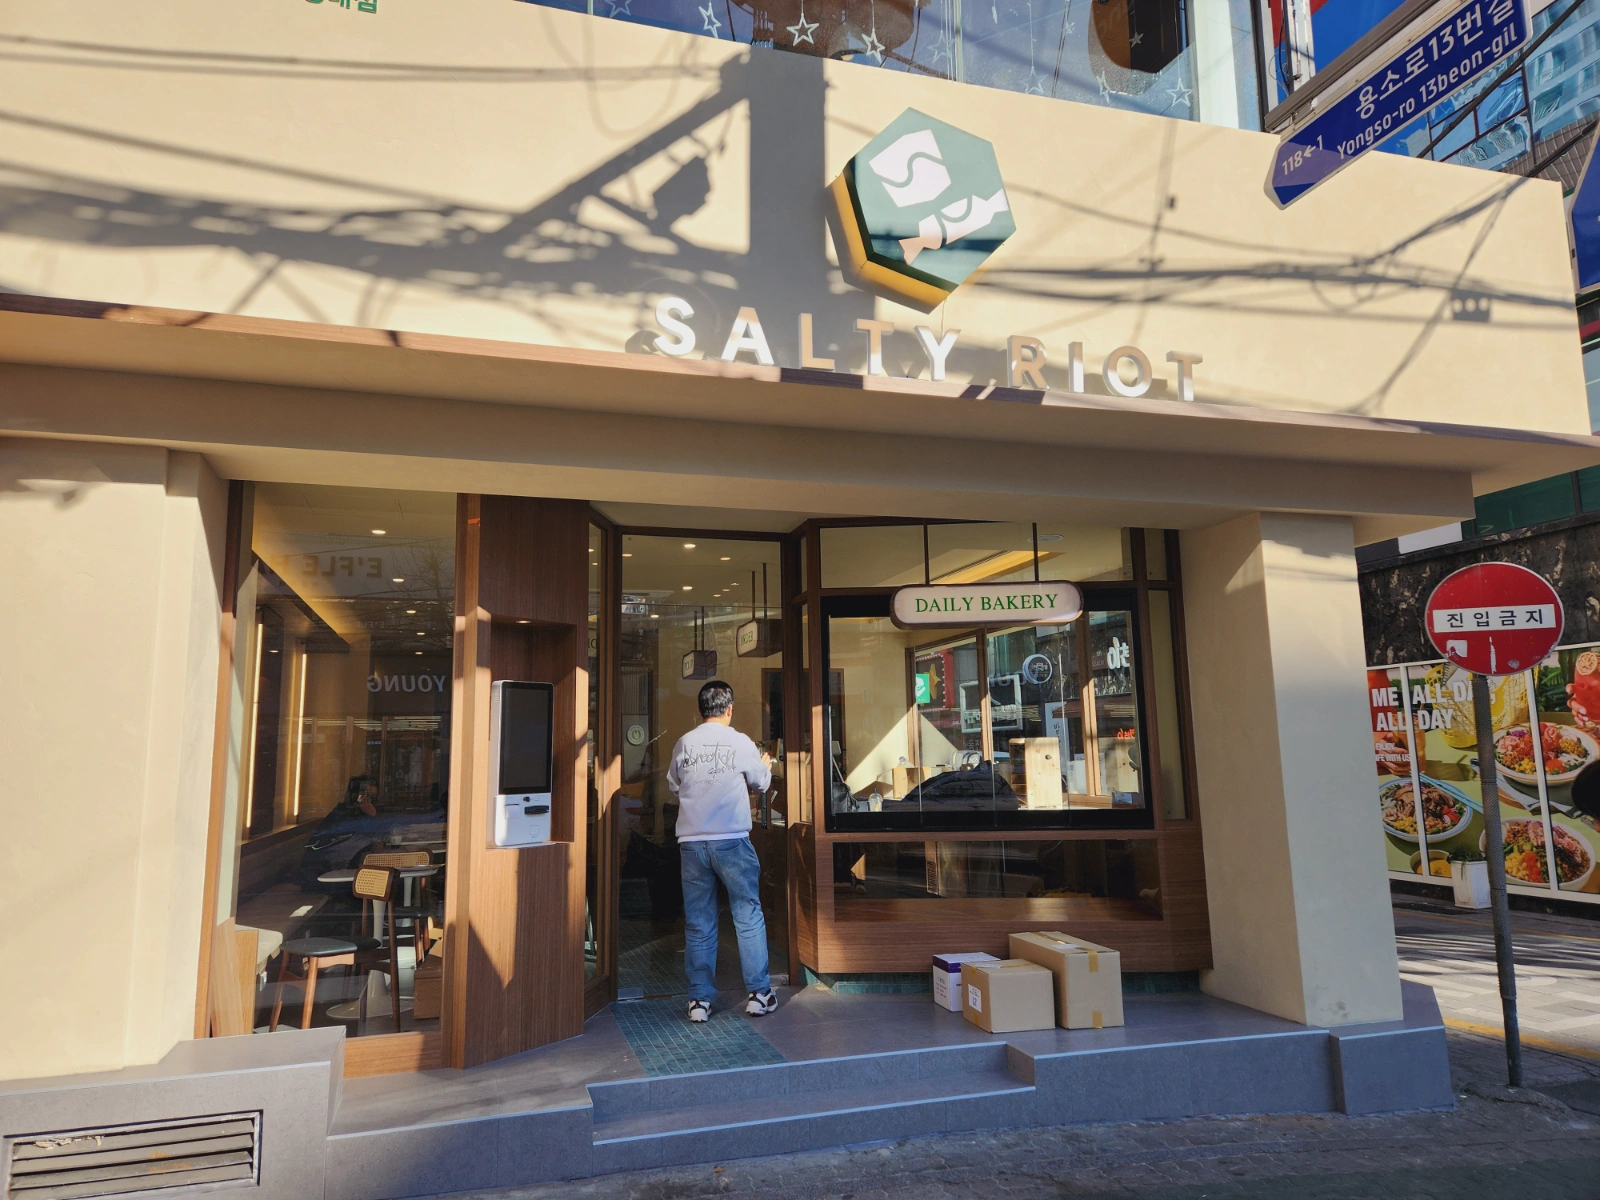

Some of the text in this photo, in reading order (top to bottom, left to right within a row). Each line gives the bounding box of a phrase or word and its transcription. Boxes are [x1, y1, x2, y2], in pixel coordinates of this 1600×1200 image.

[1336, 22, 1519, 160] Yongso-ro 13beon-gil
[1281, 149, 1303, 175] 118
[653, 296, 1204, 402] SALTY RIOT
[915, 593, 1058, 612] DAILY BAKERY
[1446, 608, 1543, 628] 진입금지
[1371, 687, 1399, 707] ME
[1412, 682, 1448, 705] ALL
[1376, 708, 1454, 731] ALL DAY
